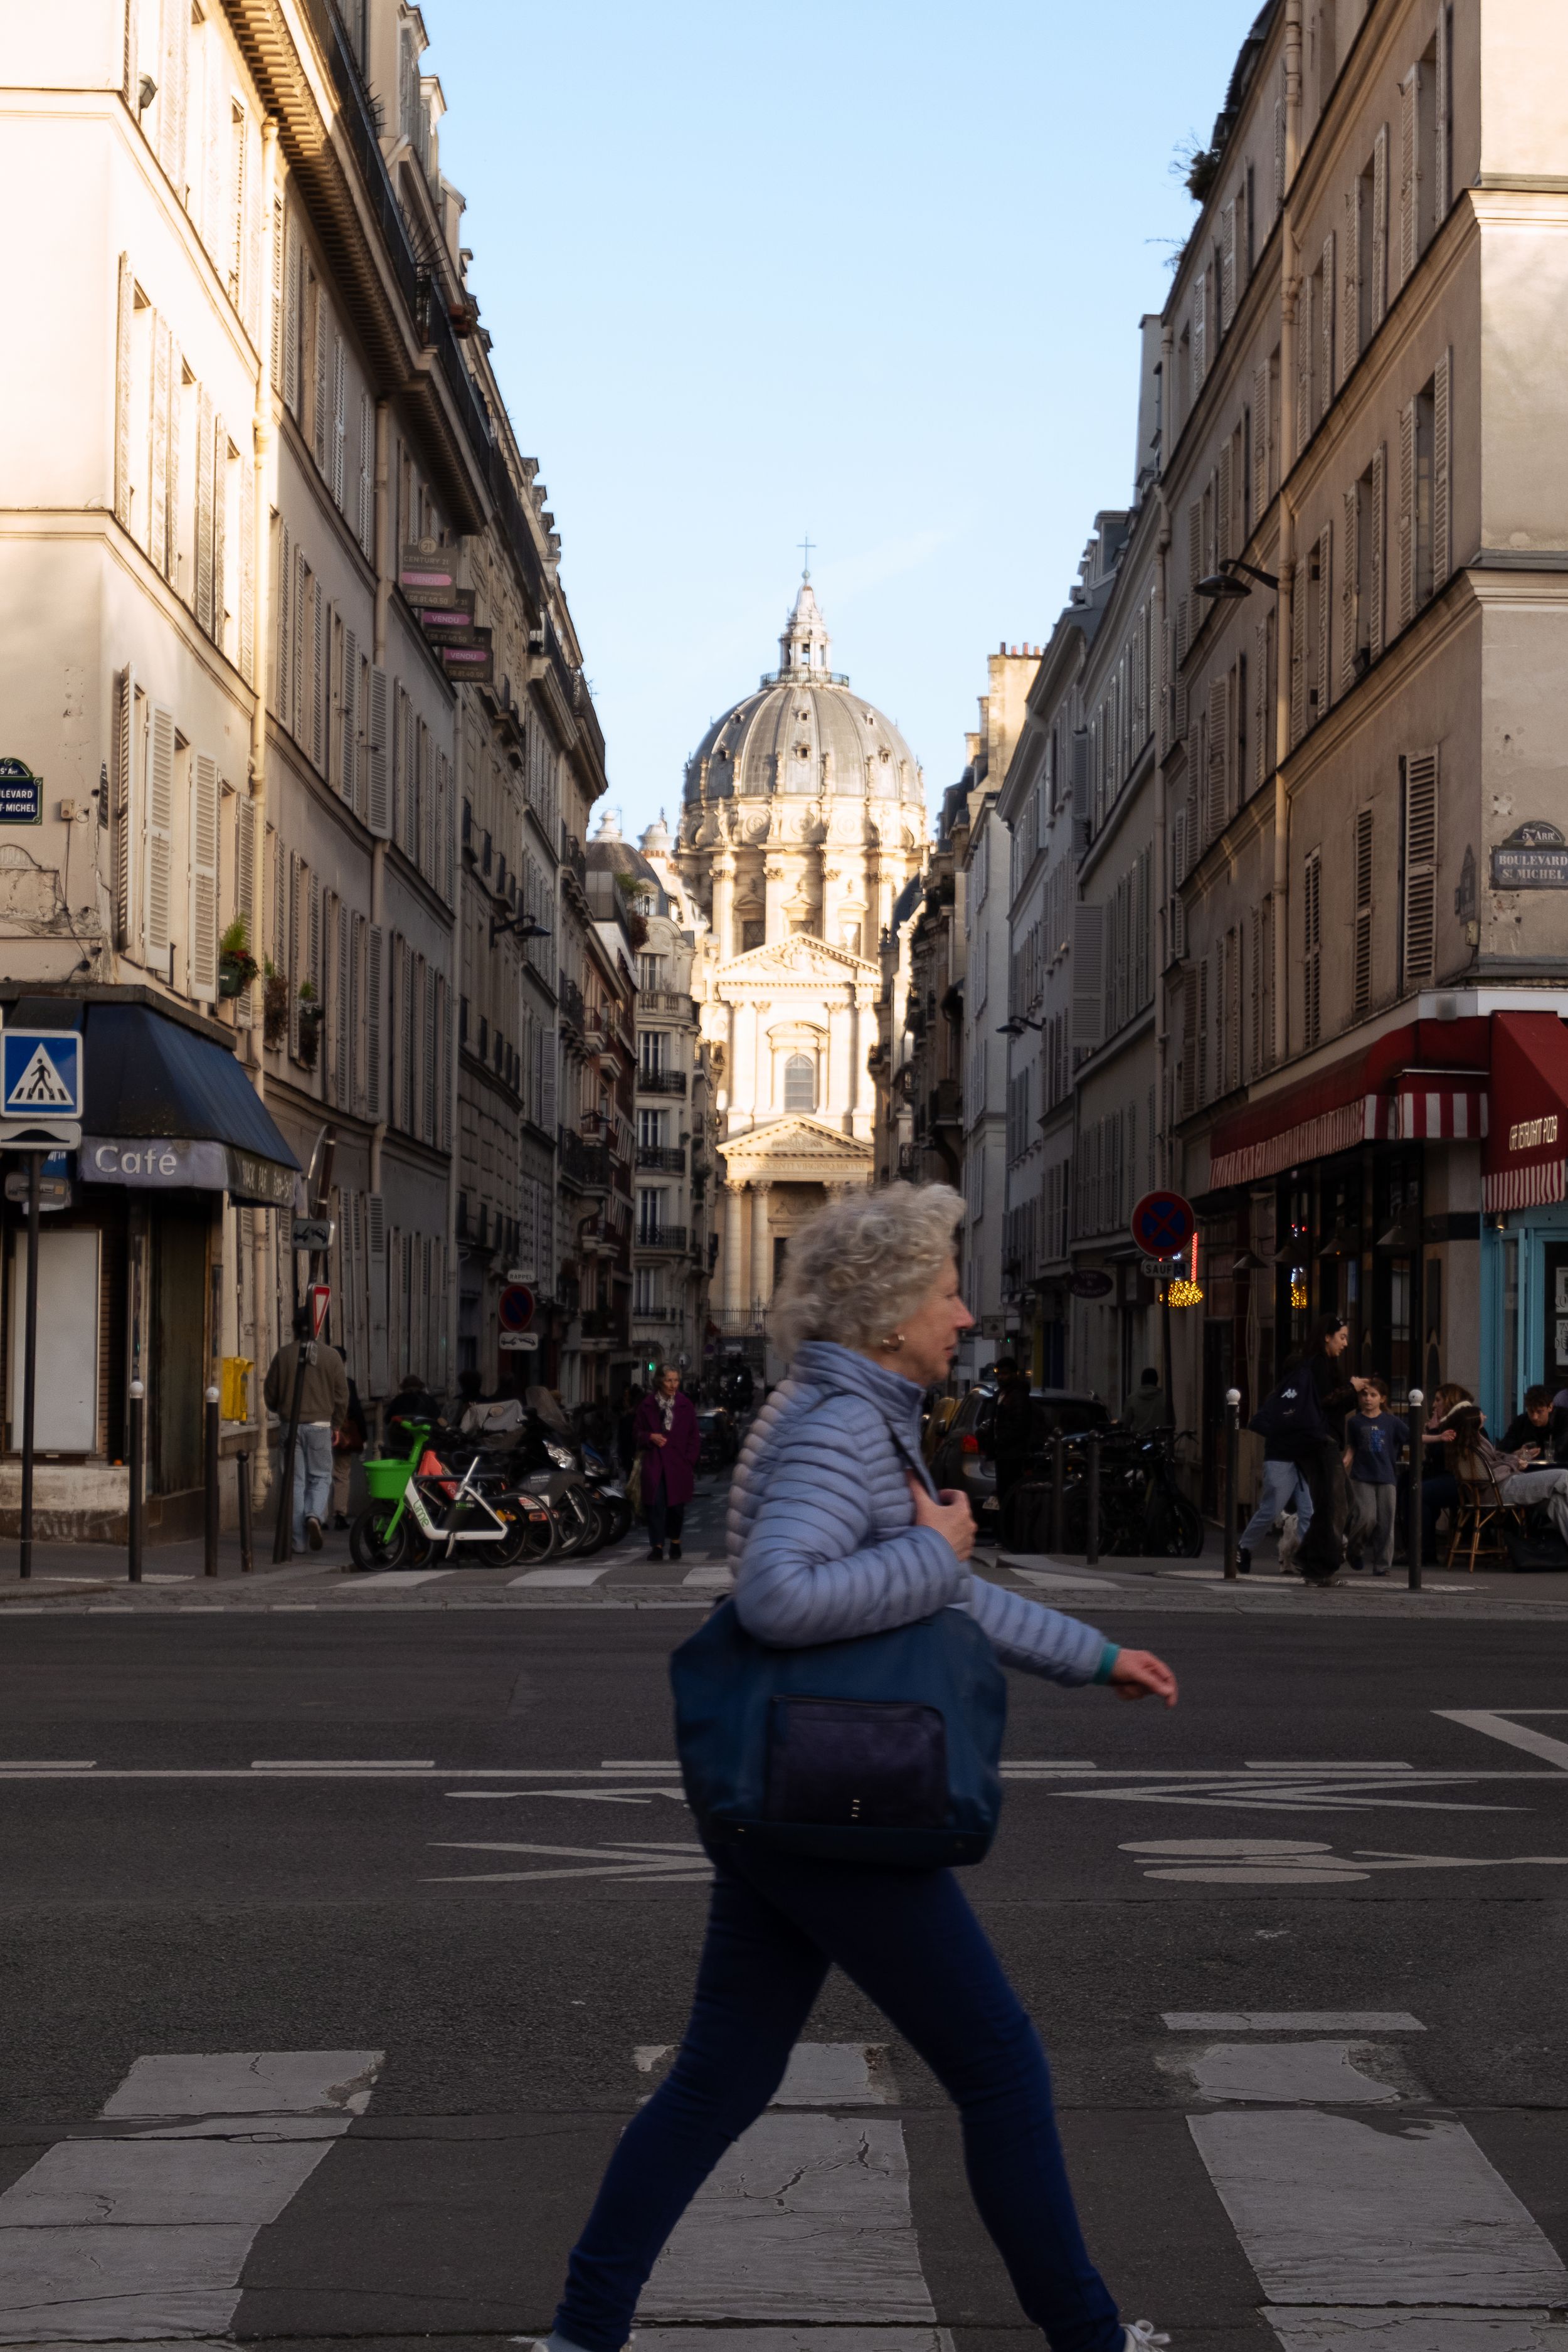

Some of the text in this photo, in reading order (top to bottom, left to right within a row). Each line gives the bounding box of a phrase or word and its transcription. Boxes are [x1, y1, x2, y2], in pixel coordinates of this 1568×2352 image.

[404, 556, 440, 564] CENTURY
[411, 576, 440, 584] VENDU
[432, 615, 459, 623] VENDU
[0, 790, 33, 798] LEVARD
[1498, 855, 1568, 866] BOULEVARD
[1517, 869, 1564, 879] MICHEL
[95, 1145, 177, 1176] Café
[1146, 1265, 1172, 1274] SAUF
[413, 1499, 430, 1527] Lime
